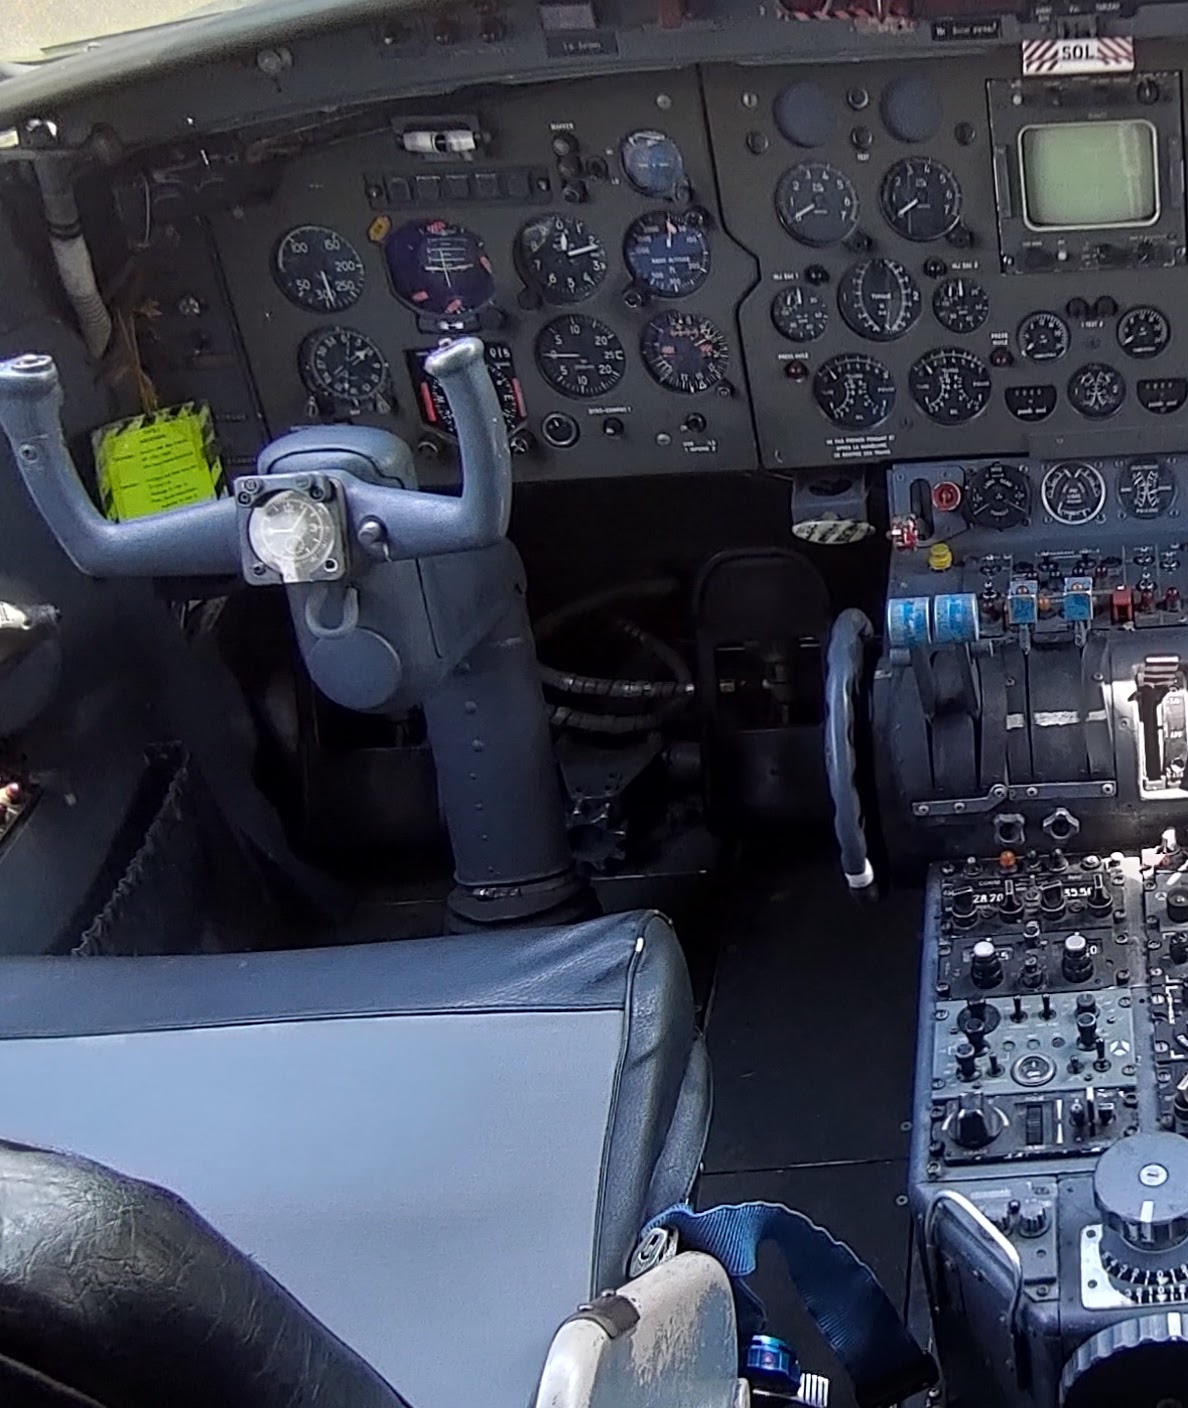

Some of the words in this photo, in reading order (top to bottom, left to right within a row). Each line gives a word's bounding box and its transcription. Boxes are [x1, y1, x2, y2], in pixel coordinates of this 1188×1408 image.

[1062, 43, 1096, 61] SOL
[334, 260, 356, 273] 200
[334, 279, 355, 292] 250
[594, 335, 608, 346] 20
[598, 363, 612, 375] 20
